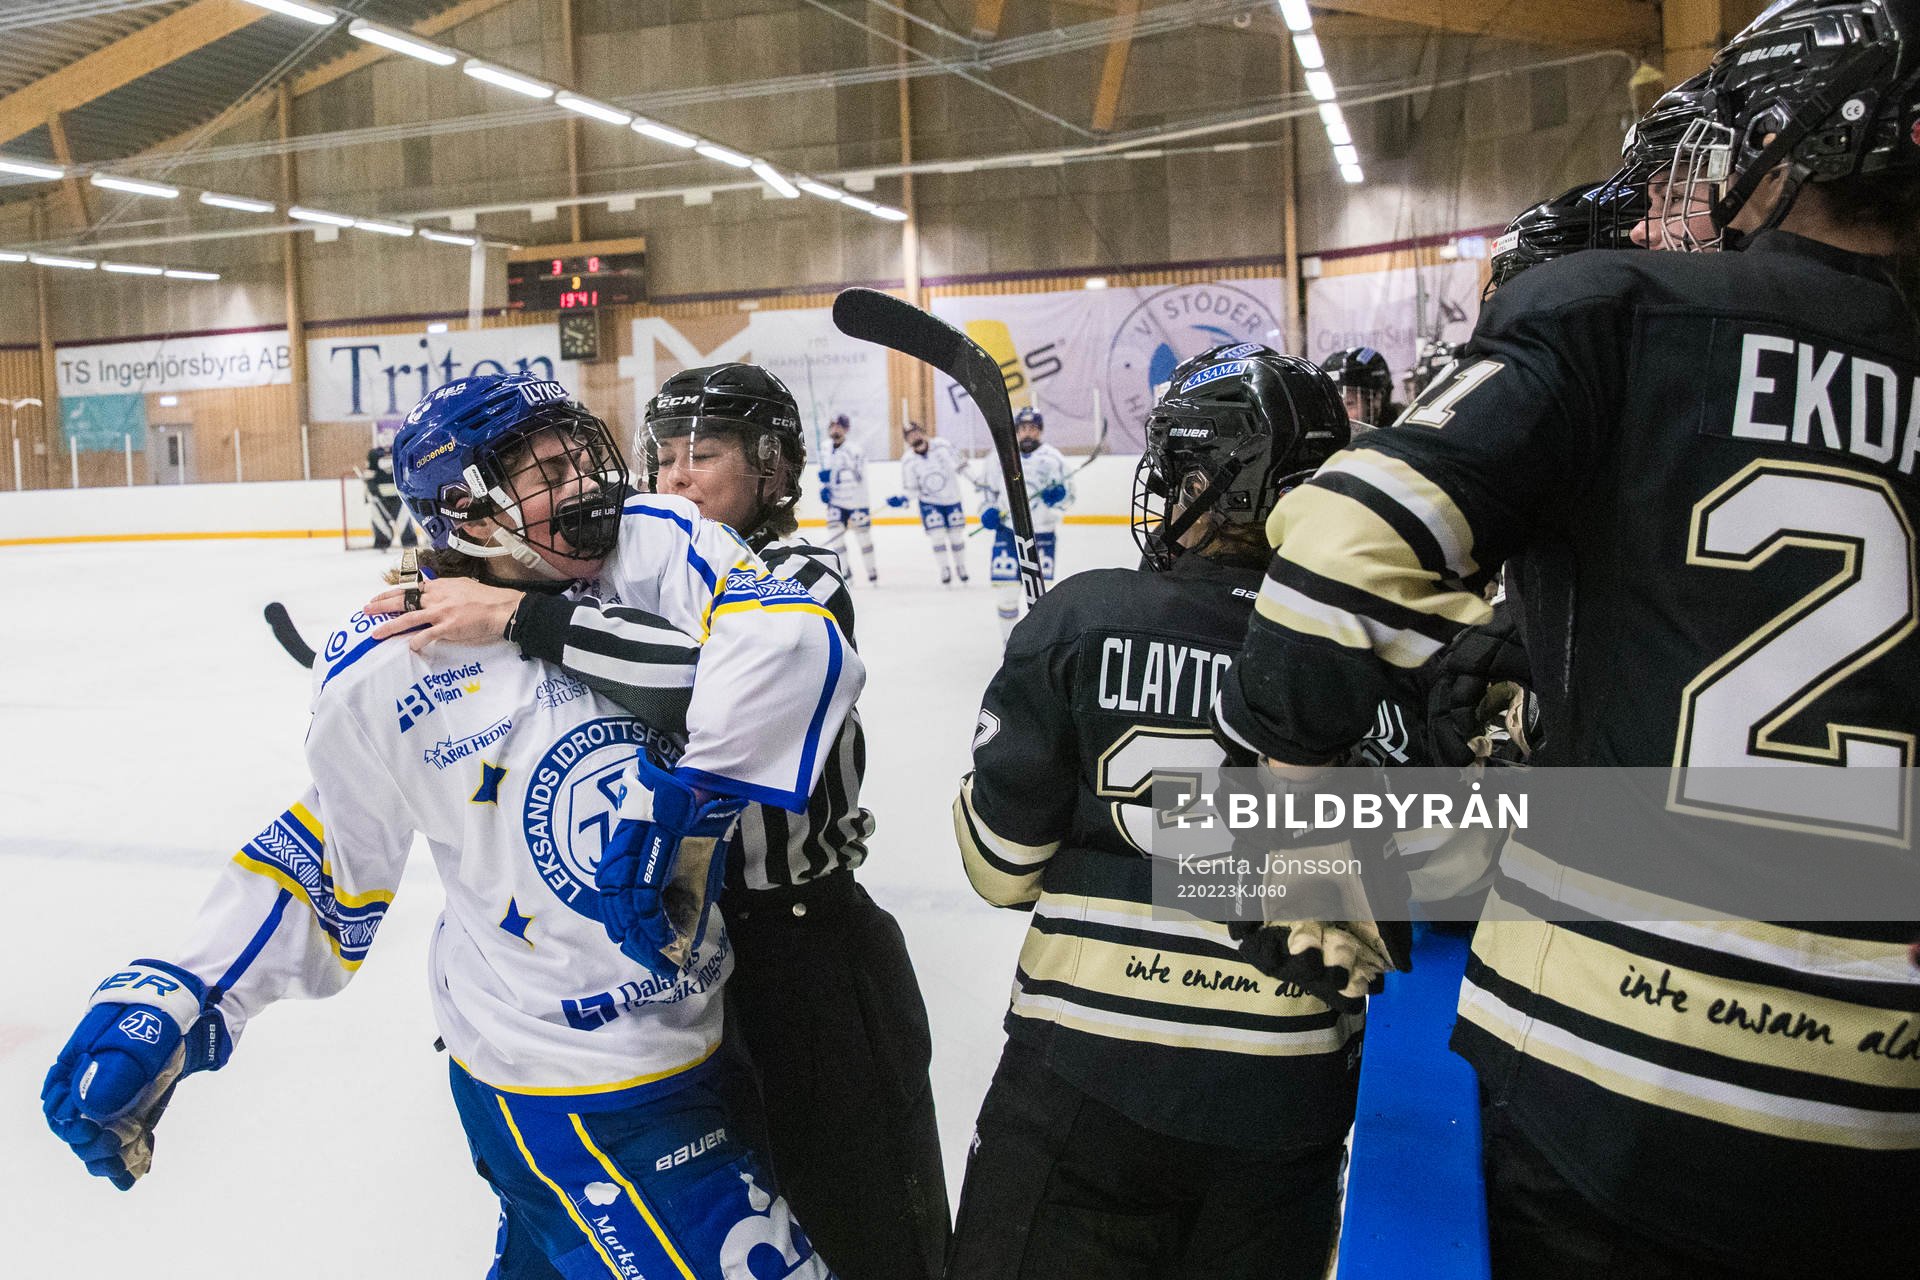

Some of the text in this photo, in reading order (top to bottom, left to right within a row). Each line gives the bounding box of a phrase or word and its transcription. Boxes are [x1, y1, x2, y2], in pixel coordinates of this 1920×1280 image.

[61, 346, 292, 387] TS Ingenjörsbyrå AB
[1183, 364, 1242, 388] KASAMA
[528, 382, 562, 401] LYKO
[657, 395, 700, 408] CCM
[1665, 457, 1919, 849] 2
[471, 719, 513, 752] HEDIN
[527, 767, 583, 904] LEKSANDS
[643, 836, 662, 884] BAUER
[655, 1127, 728, 1172] BAUER
